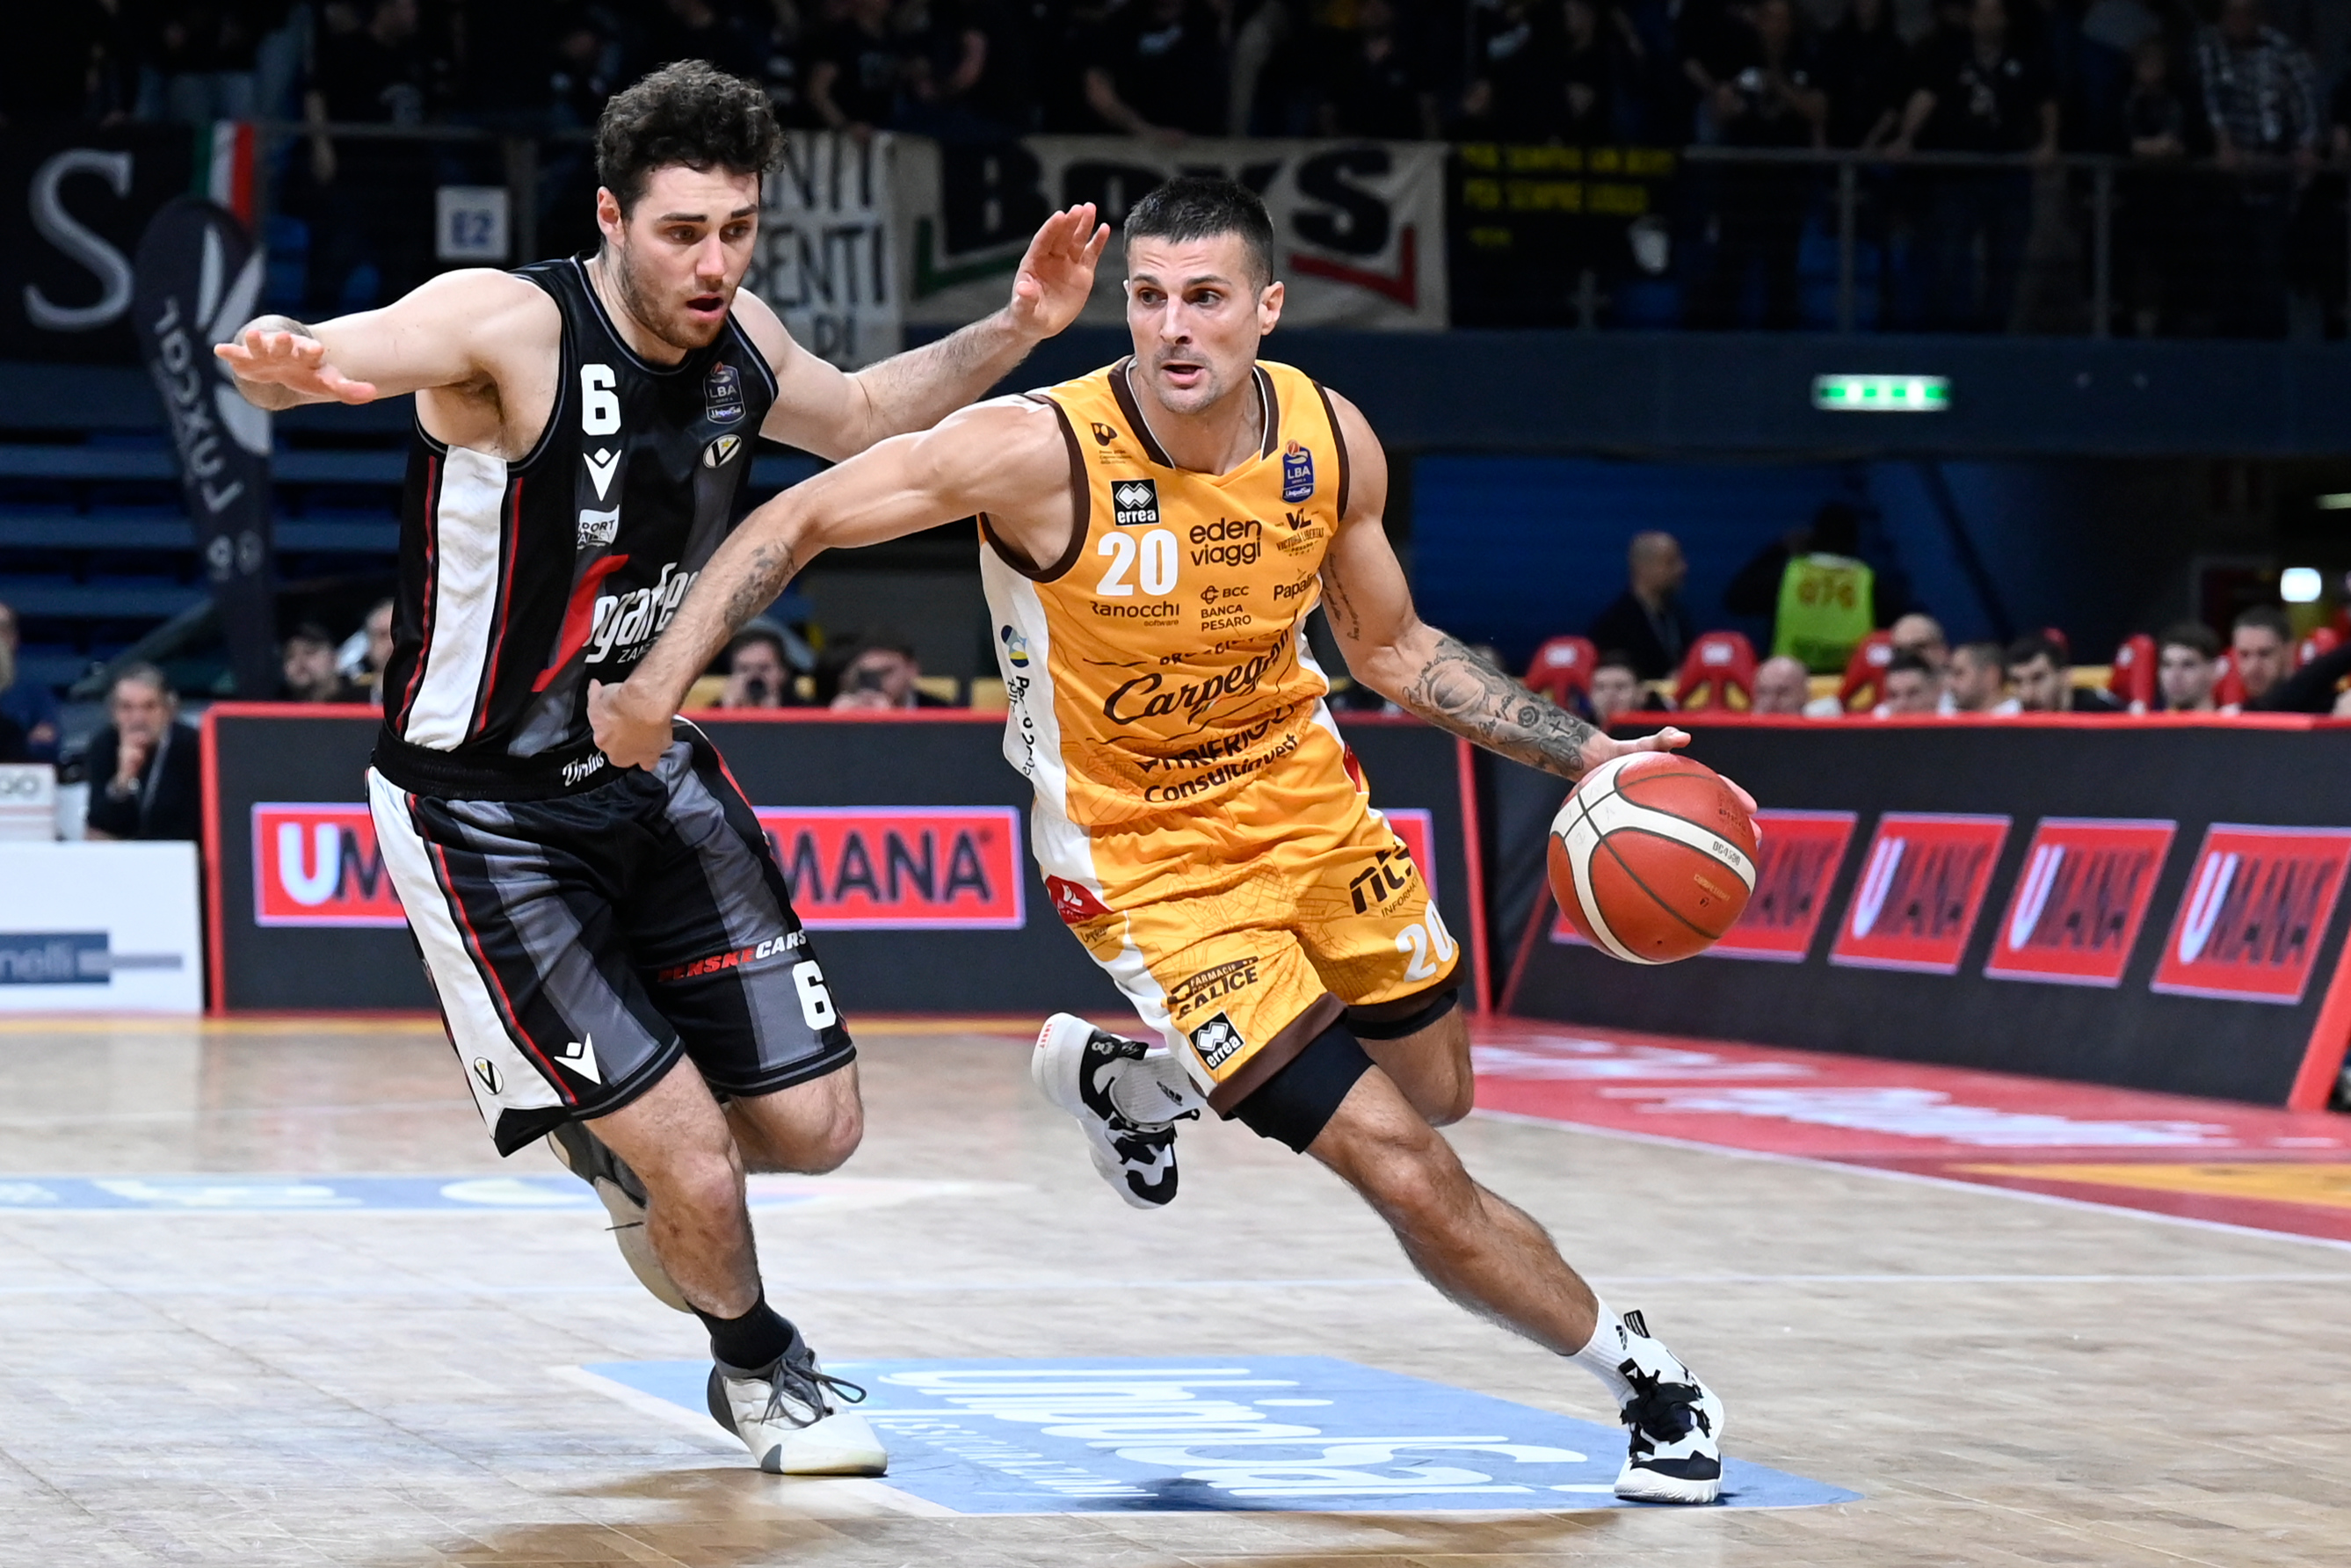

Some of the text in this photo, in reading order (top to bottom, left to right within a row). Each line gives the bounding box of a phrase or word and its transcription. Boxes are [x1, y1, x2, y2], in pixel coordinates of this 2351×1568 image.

[942, 138, 1391, 255] BOS
[451, 207, 492, 245] E2
[580, 363, 621, 436] 6
[708, 384, 737, 398] LBA
[1287, 465, 1311, 480] LBA
[577, 519, 616, 533] PORT
[1189, 518, 1263, 544] eden
[1095, 528, 1179, 597] 20
[1190, 539, 1262, 567] viaggi
[1223, 585, 1251, 599] BCC
[1143, 619, 1179, 628] software
[1201, 604, 1244, 619] BANCA
[1201, 615, 1252, 633] PESARO
[1144, 733, 1298, 802] Consultinvest
[1395, 899, 1454, 983] 20
[792, 960, 837, 1031] 6
